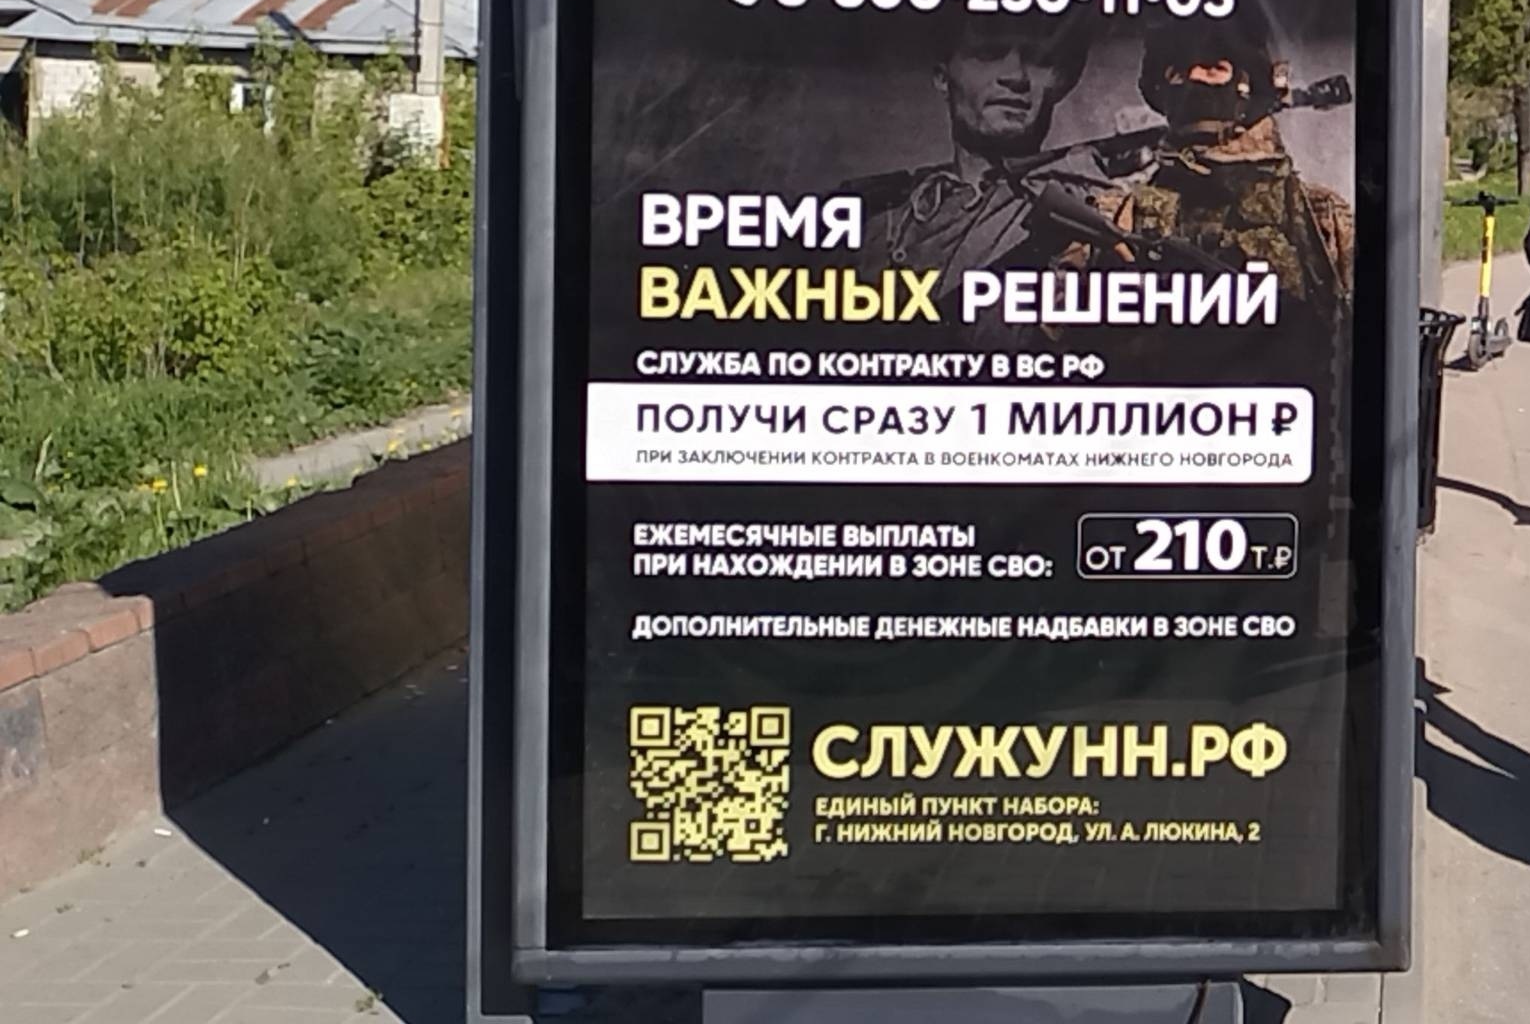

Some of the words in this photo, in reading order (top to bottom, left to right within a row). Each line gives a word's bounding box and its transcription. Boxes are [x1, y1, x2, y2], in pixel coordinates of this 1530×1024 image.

[642, 193, 862, 249] ВРЕМЯ
[640, 266, 941, 322] ВАЖНЫХ
[962, 261, 1278, 325] РЕШЕНИЙ
[636, 350, 762, 376] СЛУЖБА
[768, 351, 812, 377] ПО
[818, 352, 985, 378] КОНТРАКТУ
[991, 353, 1011, 378] В
[1016, 353, 1055, 379] ВС
[1062, 354, 1105, 379] РФ
[637, 403, 806, 434] ПОЛУЧИ
[822, 405, 955, 435] СРАЗУ
[971, 403, 987, 435] 1
[1008, 401, 1257, 437] МИЛЛИОН
[1271, 402, 1298, 436] ₽
[636, 449, 672, 463] ПРИ
[678, 449, 806, 465] ЗАКЛЮЧЕНИИ
[811, 450, 919, 466] КОНТРАКТА
[924, 451, 936, 466] В
[940, 451, 1079, 467] ВОЕНКОМАТАХ
[1085, 452, 1174, 467] НИЖНЕГО
[1179, 451, 1293, 469] НОВГОРОДА
[633, 523, 837, 547] ЕЖЕМЕСЯЧНЫЕ
[842, 524, 975, 548] ВЫПЛАТЫ
[1085, 545, 1127, 571] ОТ
[1133, 518, 1247, 571] 210
[633, 553, 687, 576] ПРИ
[692, 553, 883, 580] НАХОЖДЕНИИ
[889, 554, 907, 577] В
[911, 554, 982, 578] ЗОНЕ
[987, 554, 1053, 578] СВО:
[631, 615, 871, 640] ДОПОЛНИТЕЛЬНЫЕ
[874, 616, 1012, 640] ДЕНЕЖНЫЕ
[1017, 616, 1148, 640] НАДБАВКИ
[1153, 616, 1169, 637] В
[1173, 615, 1238, 637] ЗОНЕ
[1242, 615, 1296, 637] СВО
[812, 722, 1287, 779] СЛУЖУНН.РФ
[815, 793, 917, 819] ЕДИНЫЙ
[921, 796, 998, 816] ПУНКТ
[1003, 796, 1099, 815] НАБОРА:
[815, 823, 831, 843] Г.
[837, 819, 943, 842] НИЖНИЙ
[948, 822, 1079, 844] НОВГОРОД,
[1085, 822, 1117, 841] УЛ.
[1122, 822, 1140, 841] А.
[1143, 822, 1244, 843] ЛЮКИНА,
[1248, 822, 1261, 841] 2
